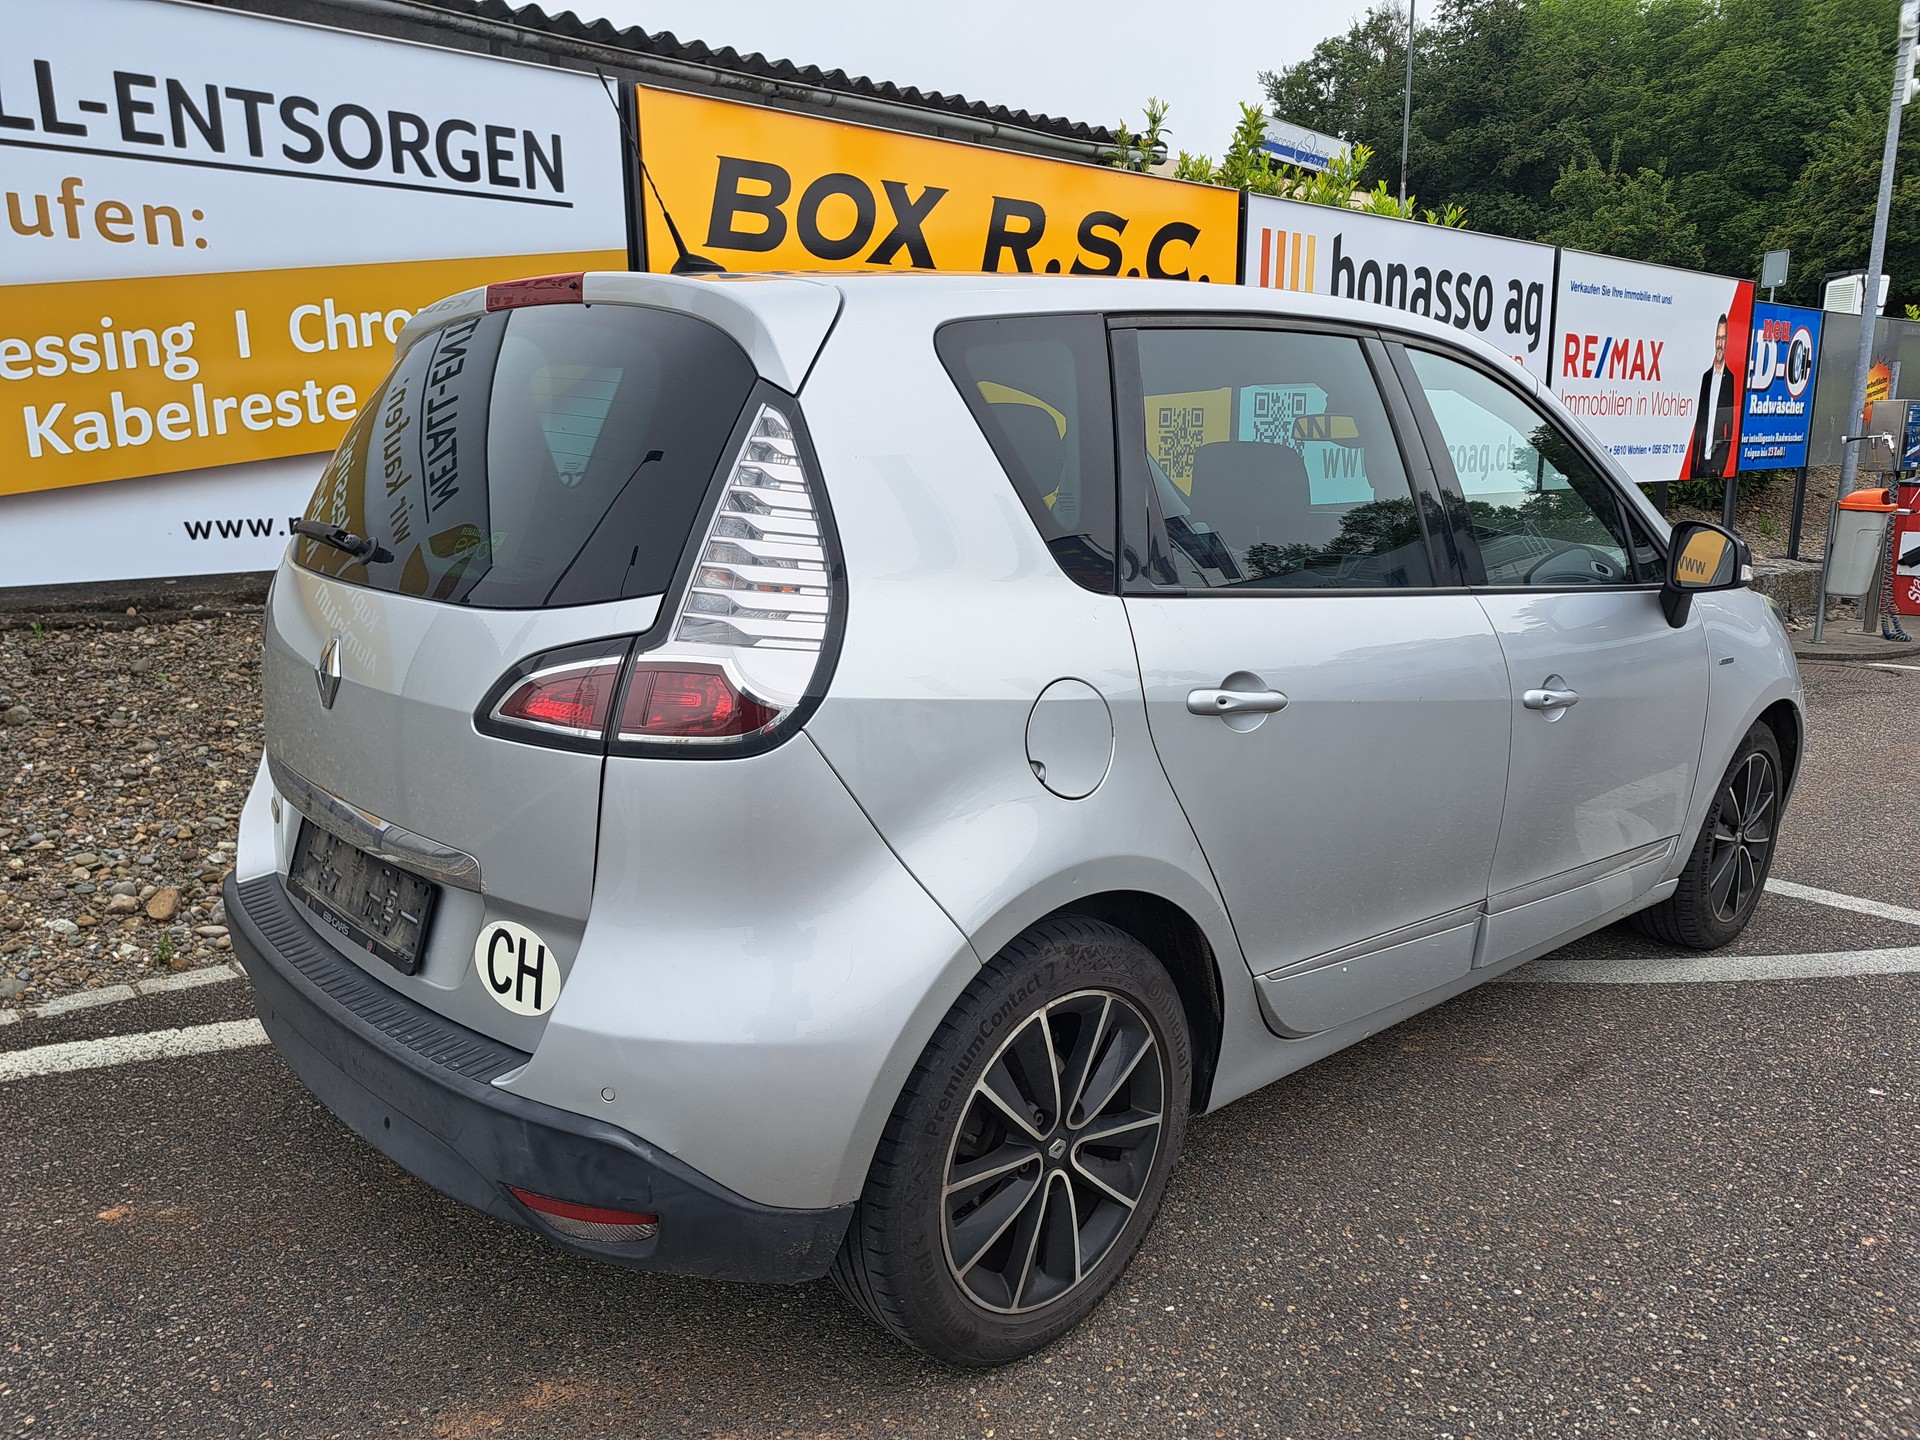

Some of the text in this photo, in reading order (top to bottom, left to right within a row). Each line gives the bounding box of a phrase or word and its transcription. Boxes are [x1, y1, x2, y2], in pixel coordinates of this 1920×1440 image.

[703, 155, 1211, 284] BOX R.S.C.
[1331, 233, 1545, 353] bonasso ag
[1570, 280, 1674, 305] Verkaufen Sie Ihre Immobilie mit uns!
[0, 316, 200, 381] essing
[289, 298, 422, 353] Chro
[1562, 333, 1664, 382] RE/MAX
[1763, 318, 1791, 342] neu
[23, 382, 357, 459] Kabelreste
[1561, 388, 1693, 417] Immobilien in Wohlen
[1749, 394, 1805, 415] Radwäscher
[1613, 445, 1627, 456] 5610
[1627, 444, 1648, 455] Wohlen
[1652, 444, 1662, 455] 056
[1662, 443, 1671, 454] 521
[487, 928, 546, 1011] CH
[924, 972, 1044, 1137] PremiumContact
